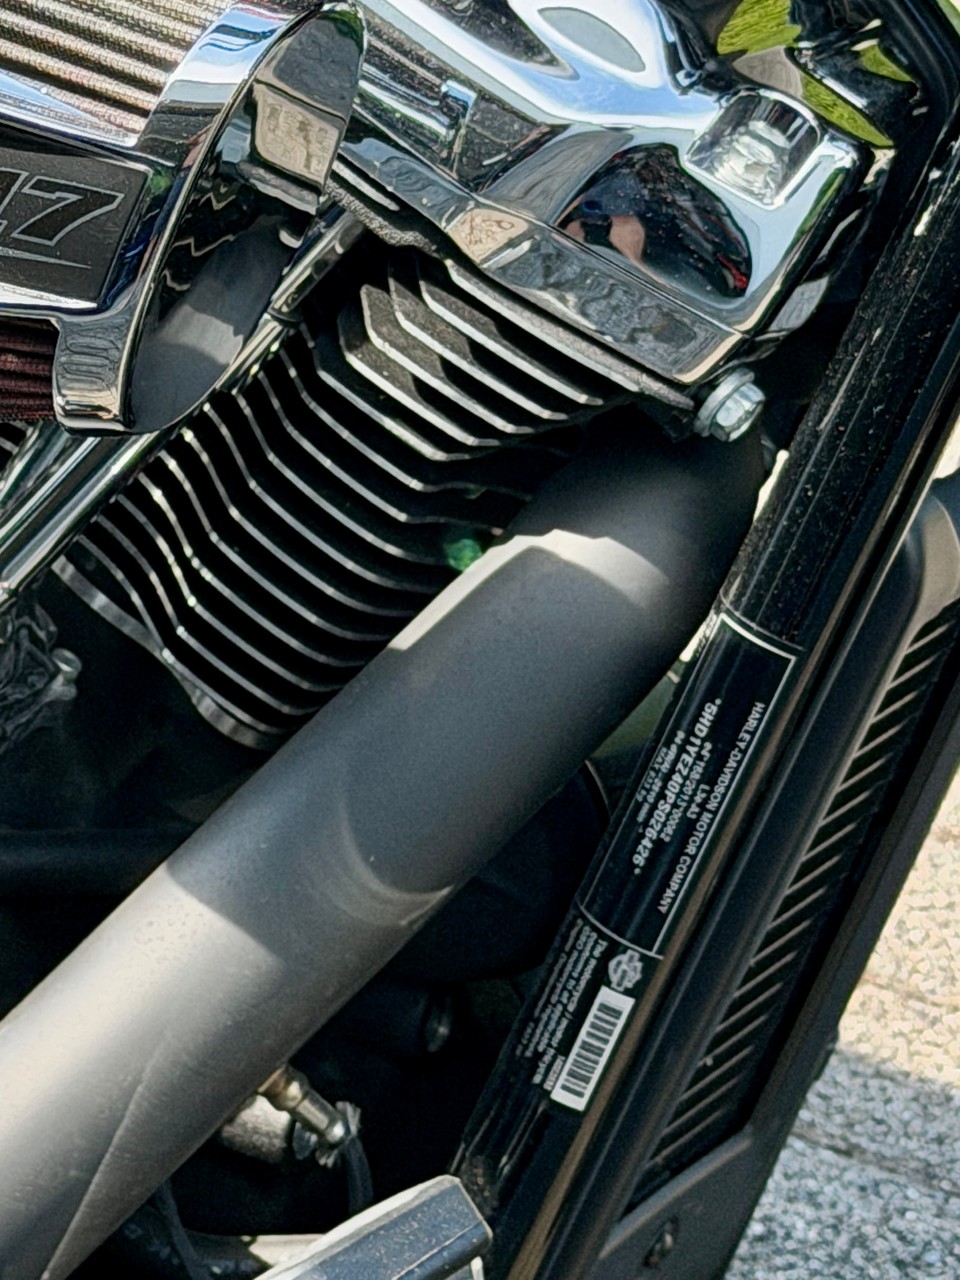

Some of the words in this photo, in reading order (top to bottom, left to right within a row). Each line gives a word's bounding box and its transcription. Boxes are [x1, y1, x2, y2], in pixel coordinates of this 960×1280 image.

[704, 700, 766, 811] HARLEY-DAVIDSON
[683, 810, 713, 856] MOTOR
[655, 853, 691, 914] COMPANY
